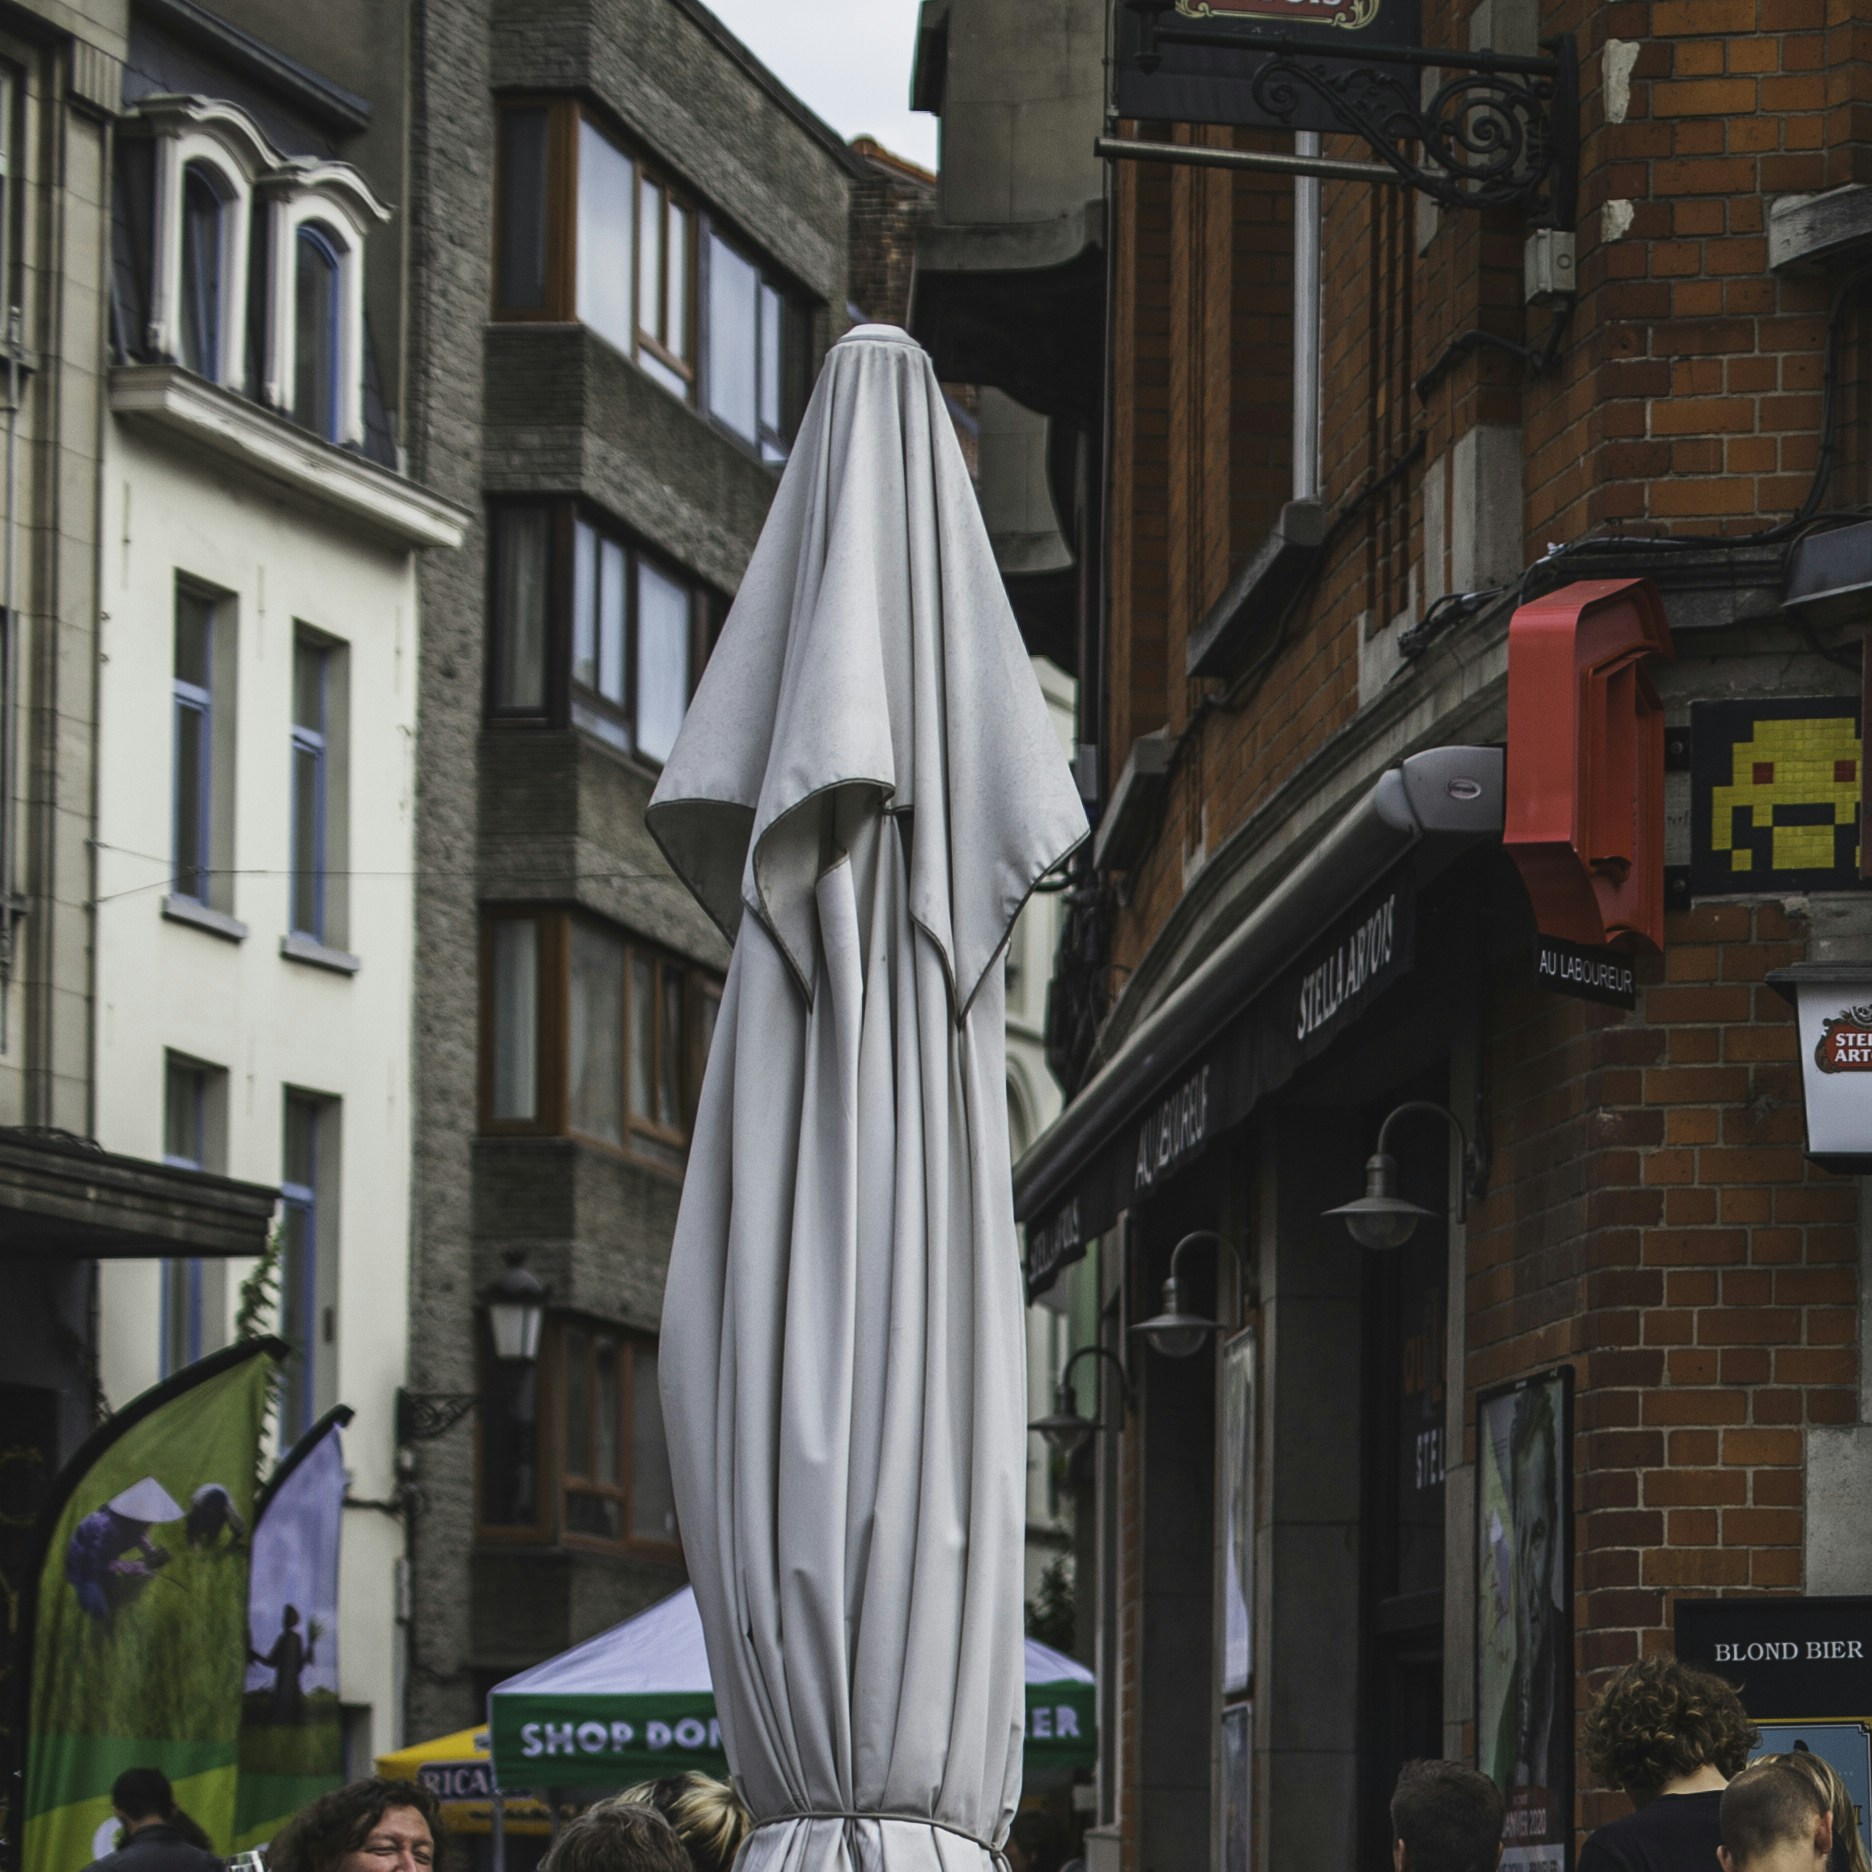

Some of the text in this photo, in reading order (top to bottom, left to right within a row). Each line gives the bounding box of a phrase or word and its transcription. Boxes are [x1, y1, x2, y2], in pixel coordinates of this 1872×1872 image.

[1297, 893, 1396, 1041] STELLA ARTOIS
[1539, 948, 1634, 994] AU LABOUREUR
[1714, 1640, 1864, 1662] BLOND BIER
[520, 1720, 634, 1758] SHOP
[419, 1766, 497, 1798] RICA
